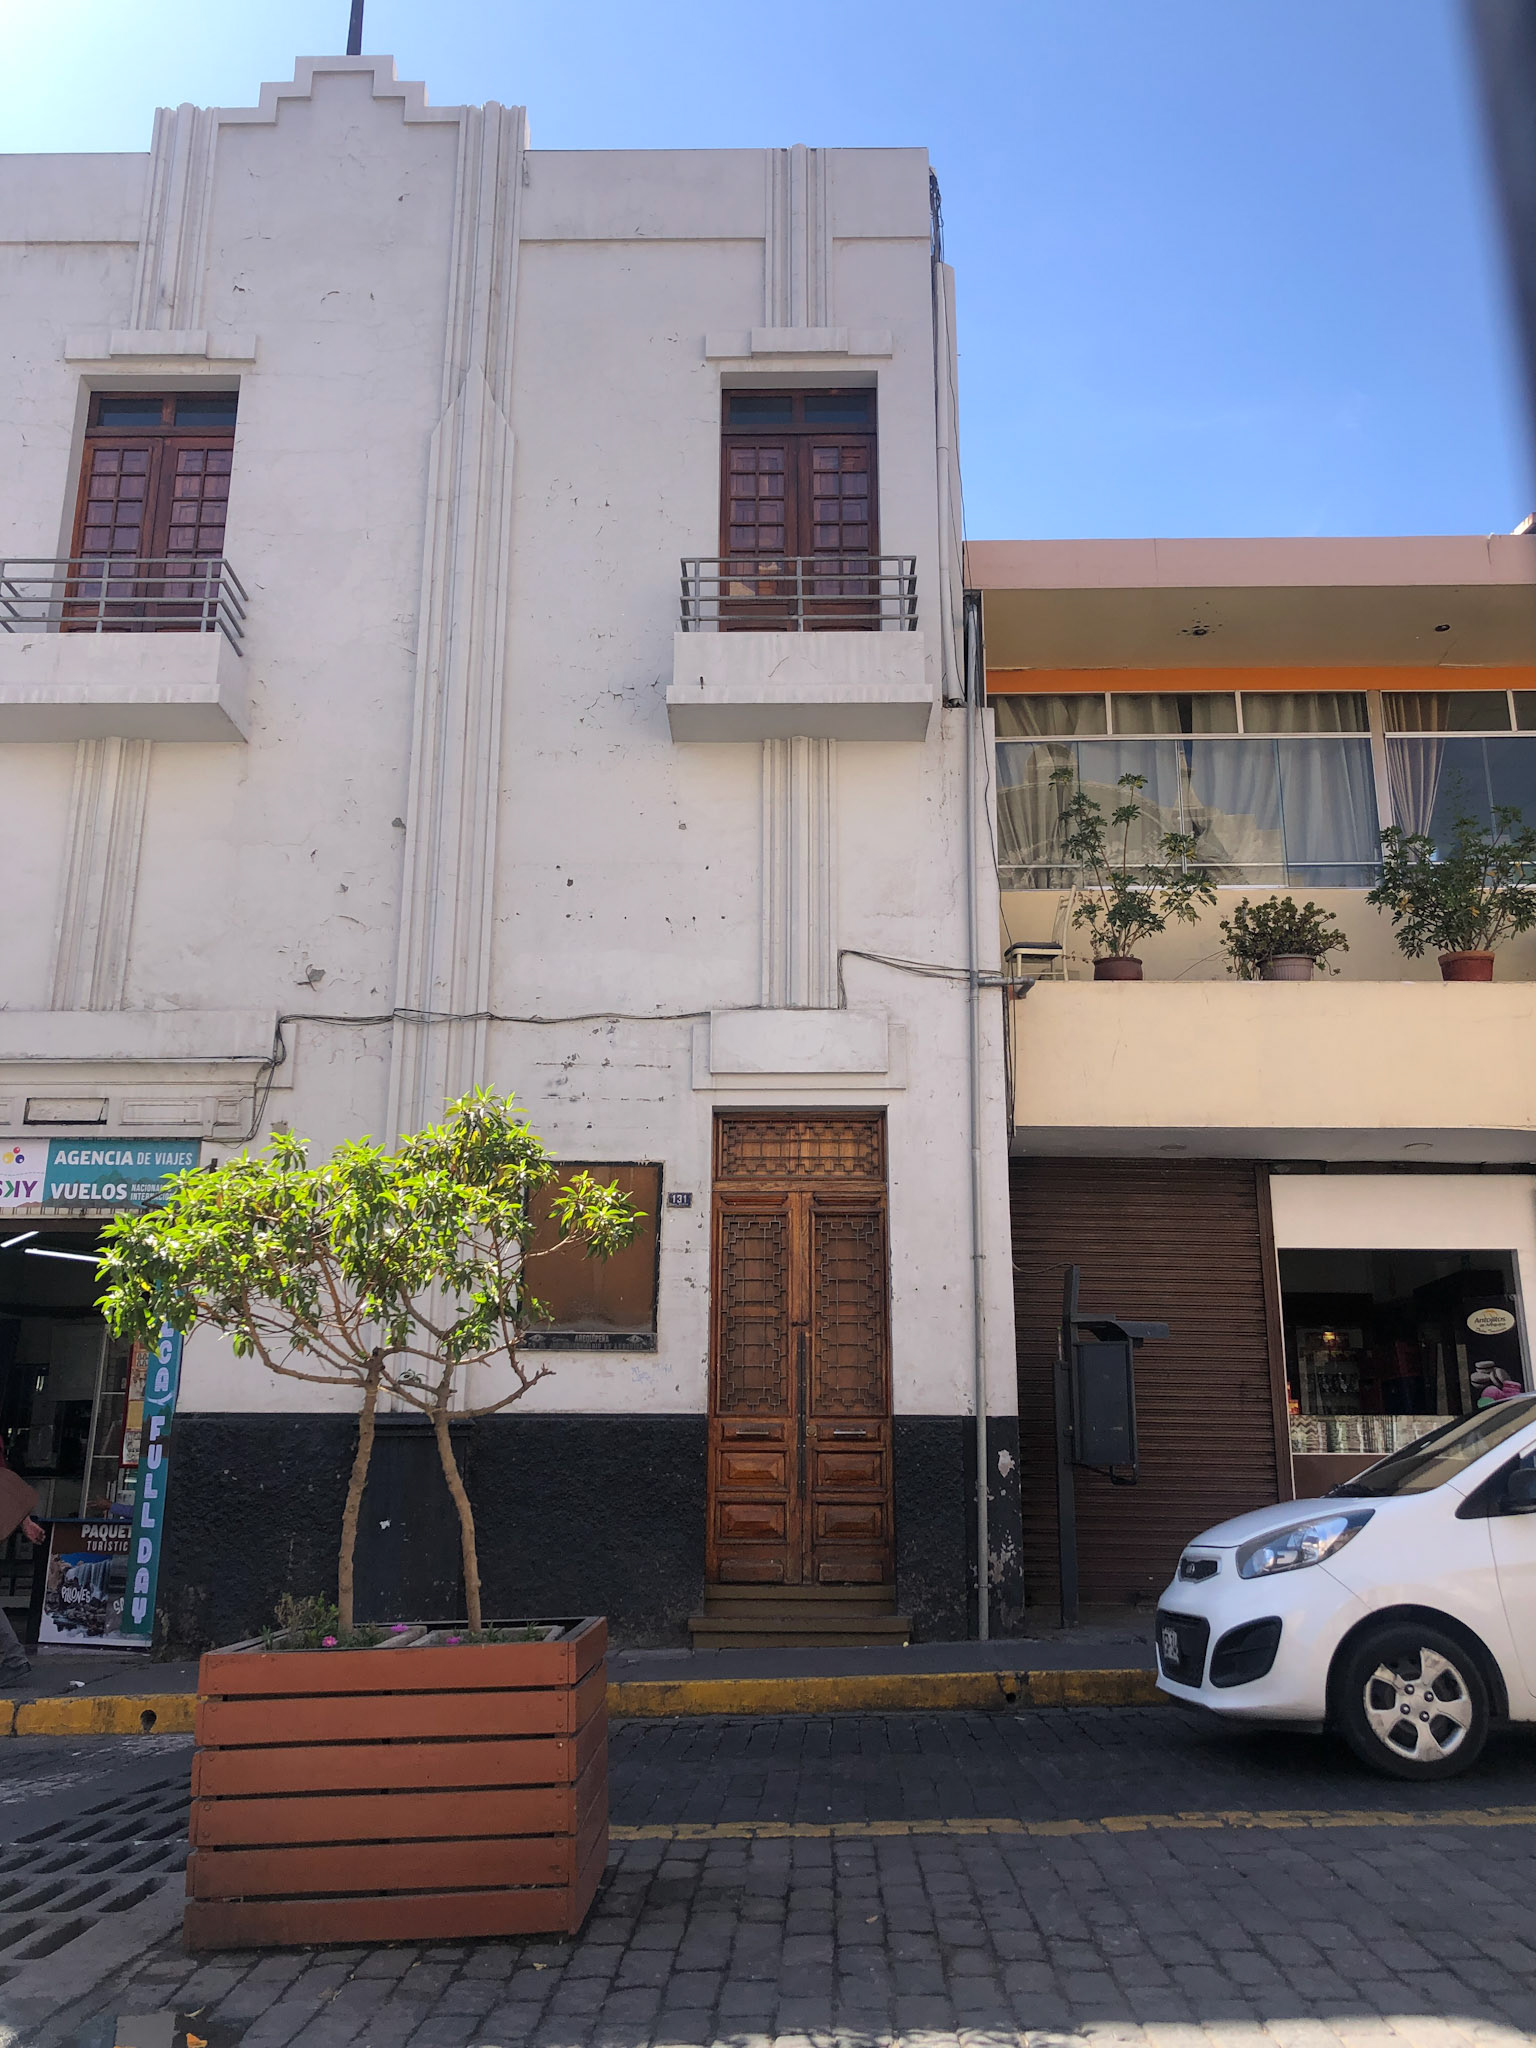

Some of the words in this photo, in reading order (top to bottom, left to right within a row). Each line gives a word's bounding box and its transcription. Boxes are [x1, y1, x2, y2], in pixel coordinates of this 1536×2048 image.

[54, 1151, 134, 1165] AGENCIA
[137, 1152, 152, 1165] DE
[155, 1152, 193, 1165] VIAJES
[51, 1183, 127, 1200] VUELOS
[672, 1195, 687, 1204] 131
[141, 1416, 165, 1528] FULL
[81, 1524, 132, 1541] PAQUET
[132, 1540, 152, 1624] DAY
